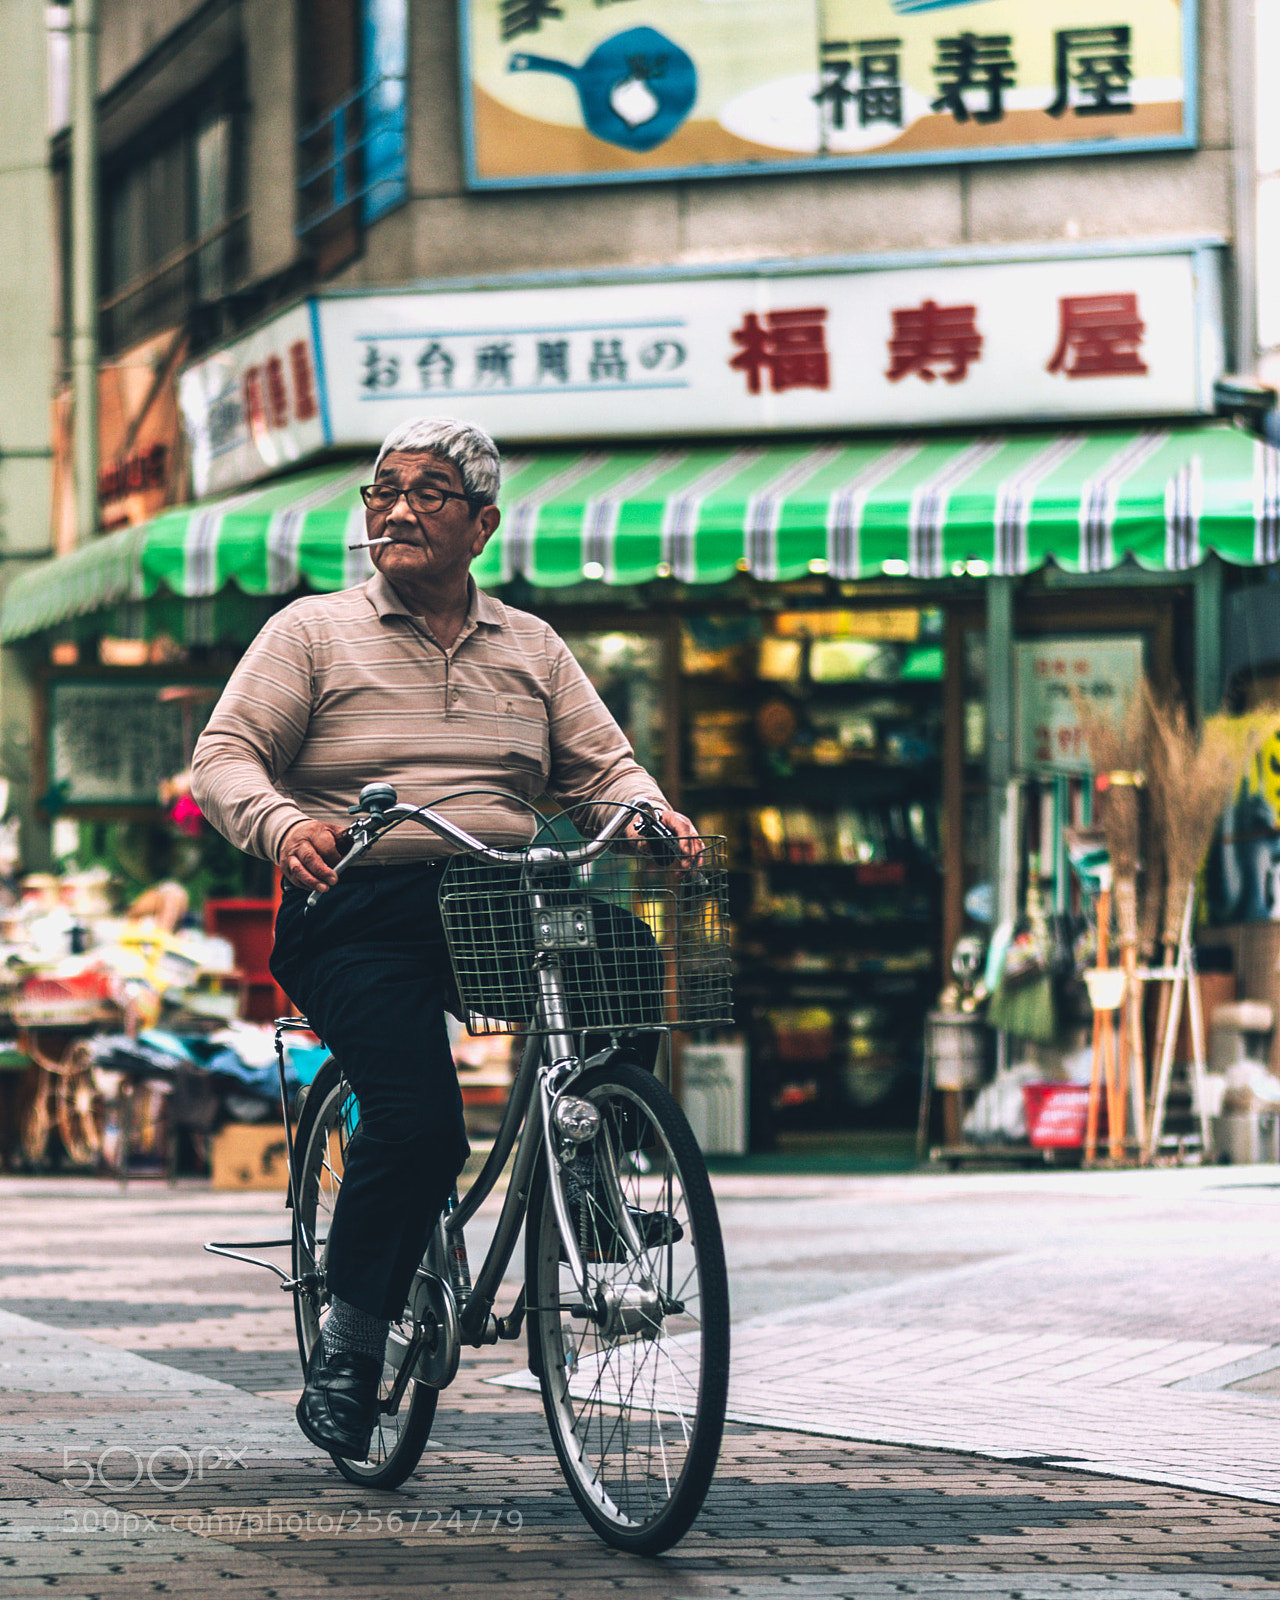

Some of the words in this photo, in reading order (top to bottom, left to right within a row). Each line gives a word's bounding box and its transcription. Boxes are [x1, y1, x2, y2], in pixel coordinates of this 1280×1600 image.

[813, 26, 1135, 129] 福寿屋
[362, 338, 687, 390] お台所用品の
[730, 293, 1149, 394] 福寿屋
